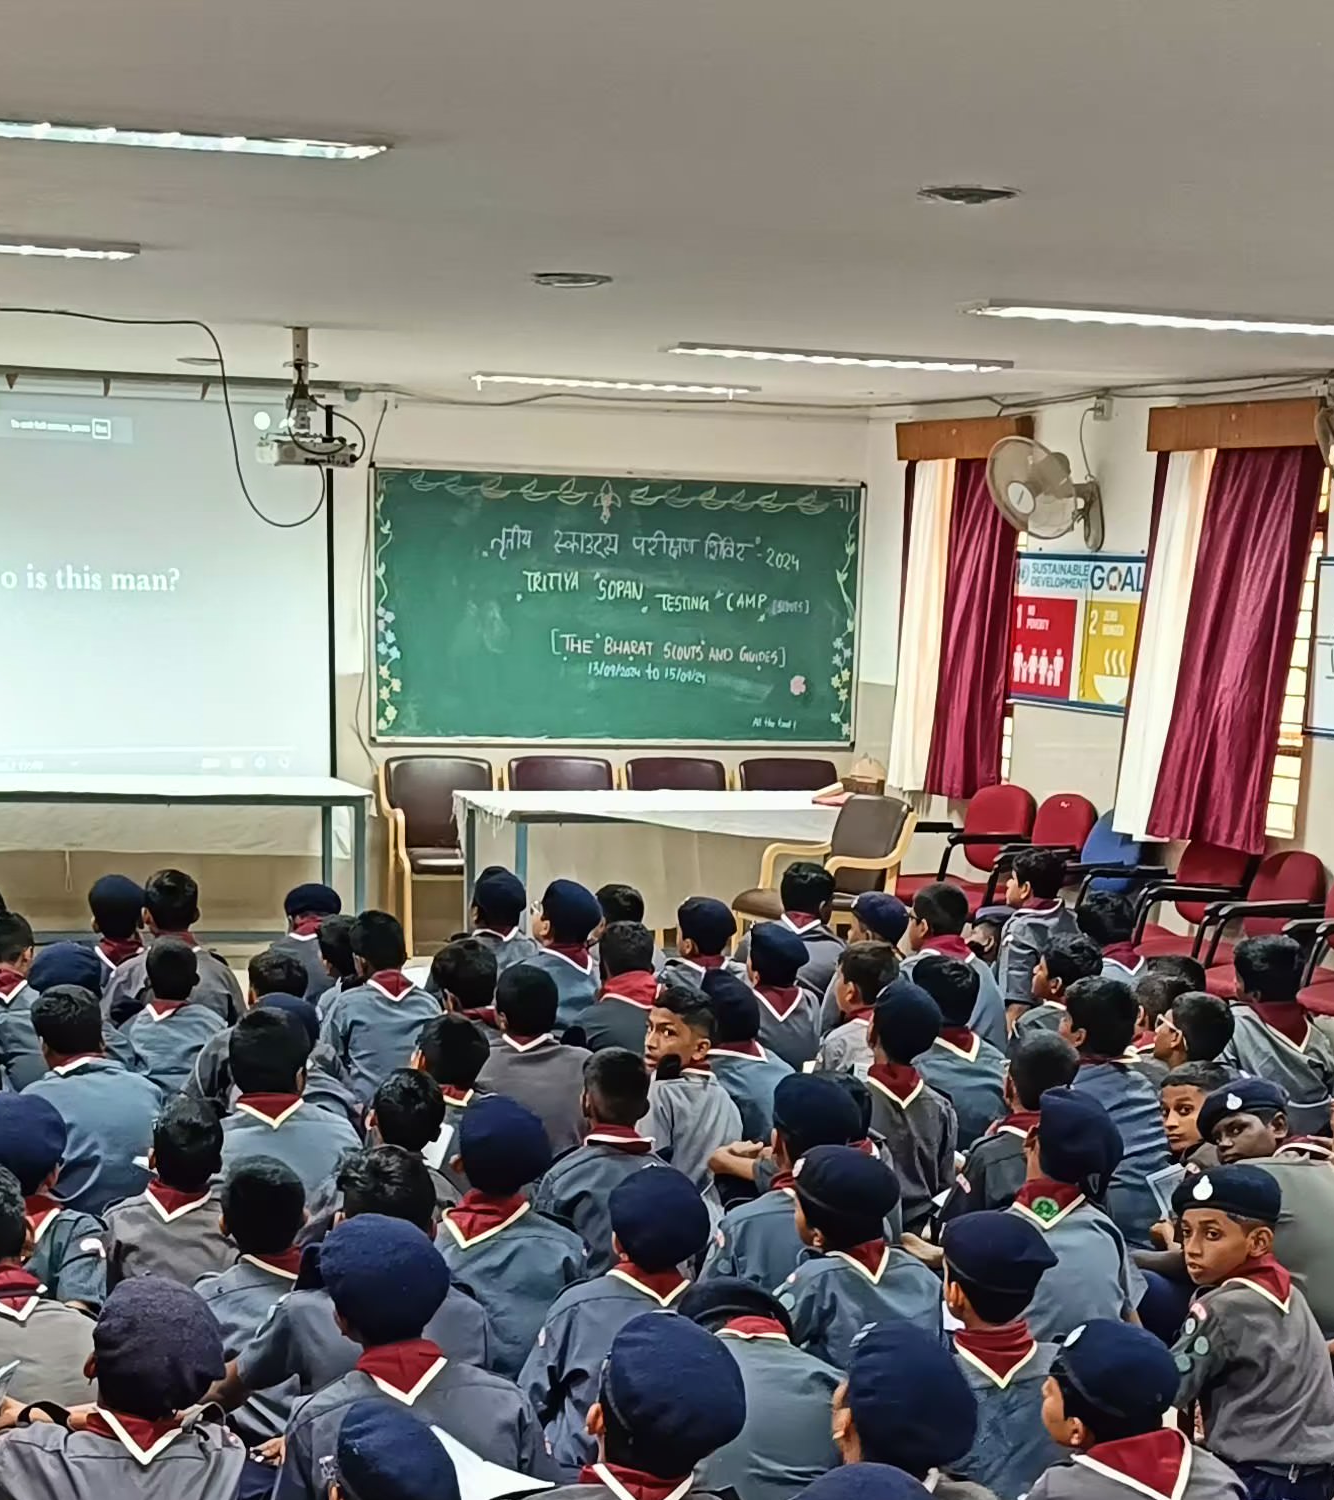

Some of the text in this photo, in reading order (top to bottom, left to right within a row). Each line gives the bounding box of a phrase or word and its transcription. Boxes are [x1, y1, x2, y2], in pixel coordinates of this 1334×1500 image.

[26, 563, 48, 591] is
[55, 564, 102, 591] this
[111, 566, 181, 593] man?
[1031, 563, 1090, 589] SUSTAINABLE DEVELOPMENT
[523, 570, 579, 593] TRITIYA
[596, 579, 643, 601] SOPAN
[655, 593, 710, 612] TESTING
[1089, 609, 1098, 634] 2
[603, 636, 653, 656] BHARAT
[708, 646, 734, 662] AND
[645, 662, 660, 680] to
